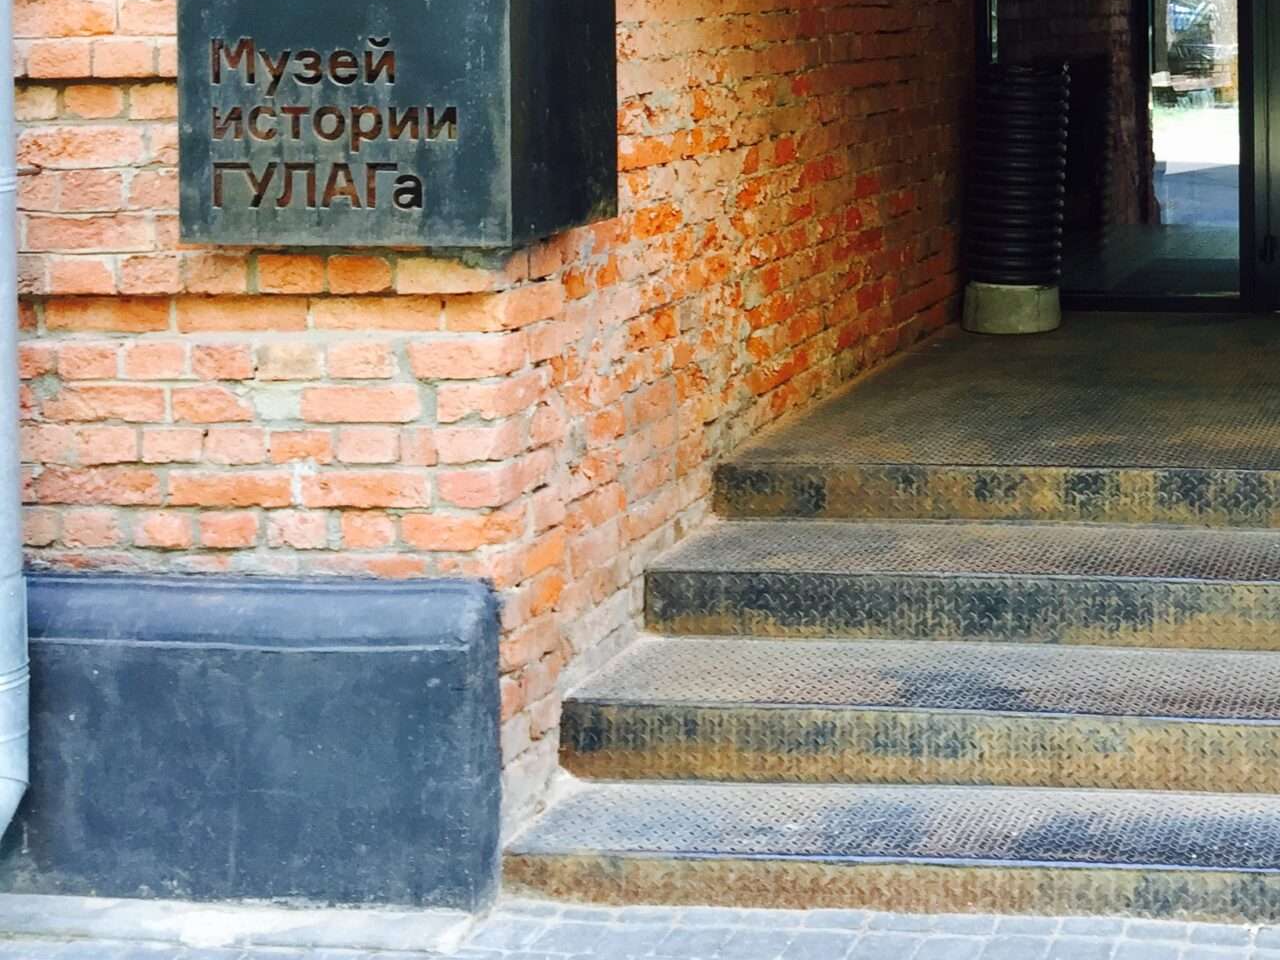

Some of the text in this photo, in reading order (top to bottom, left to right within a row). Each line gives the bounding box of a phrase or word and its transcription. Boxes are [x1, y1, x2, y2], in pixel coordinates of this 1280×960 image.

[210, 37, 396, 97] Музей
[211, 106, 458, 152] истории
[211, 162, 424, 209] ГУЛАГа
